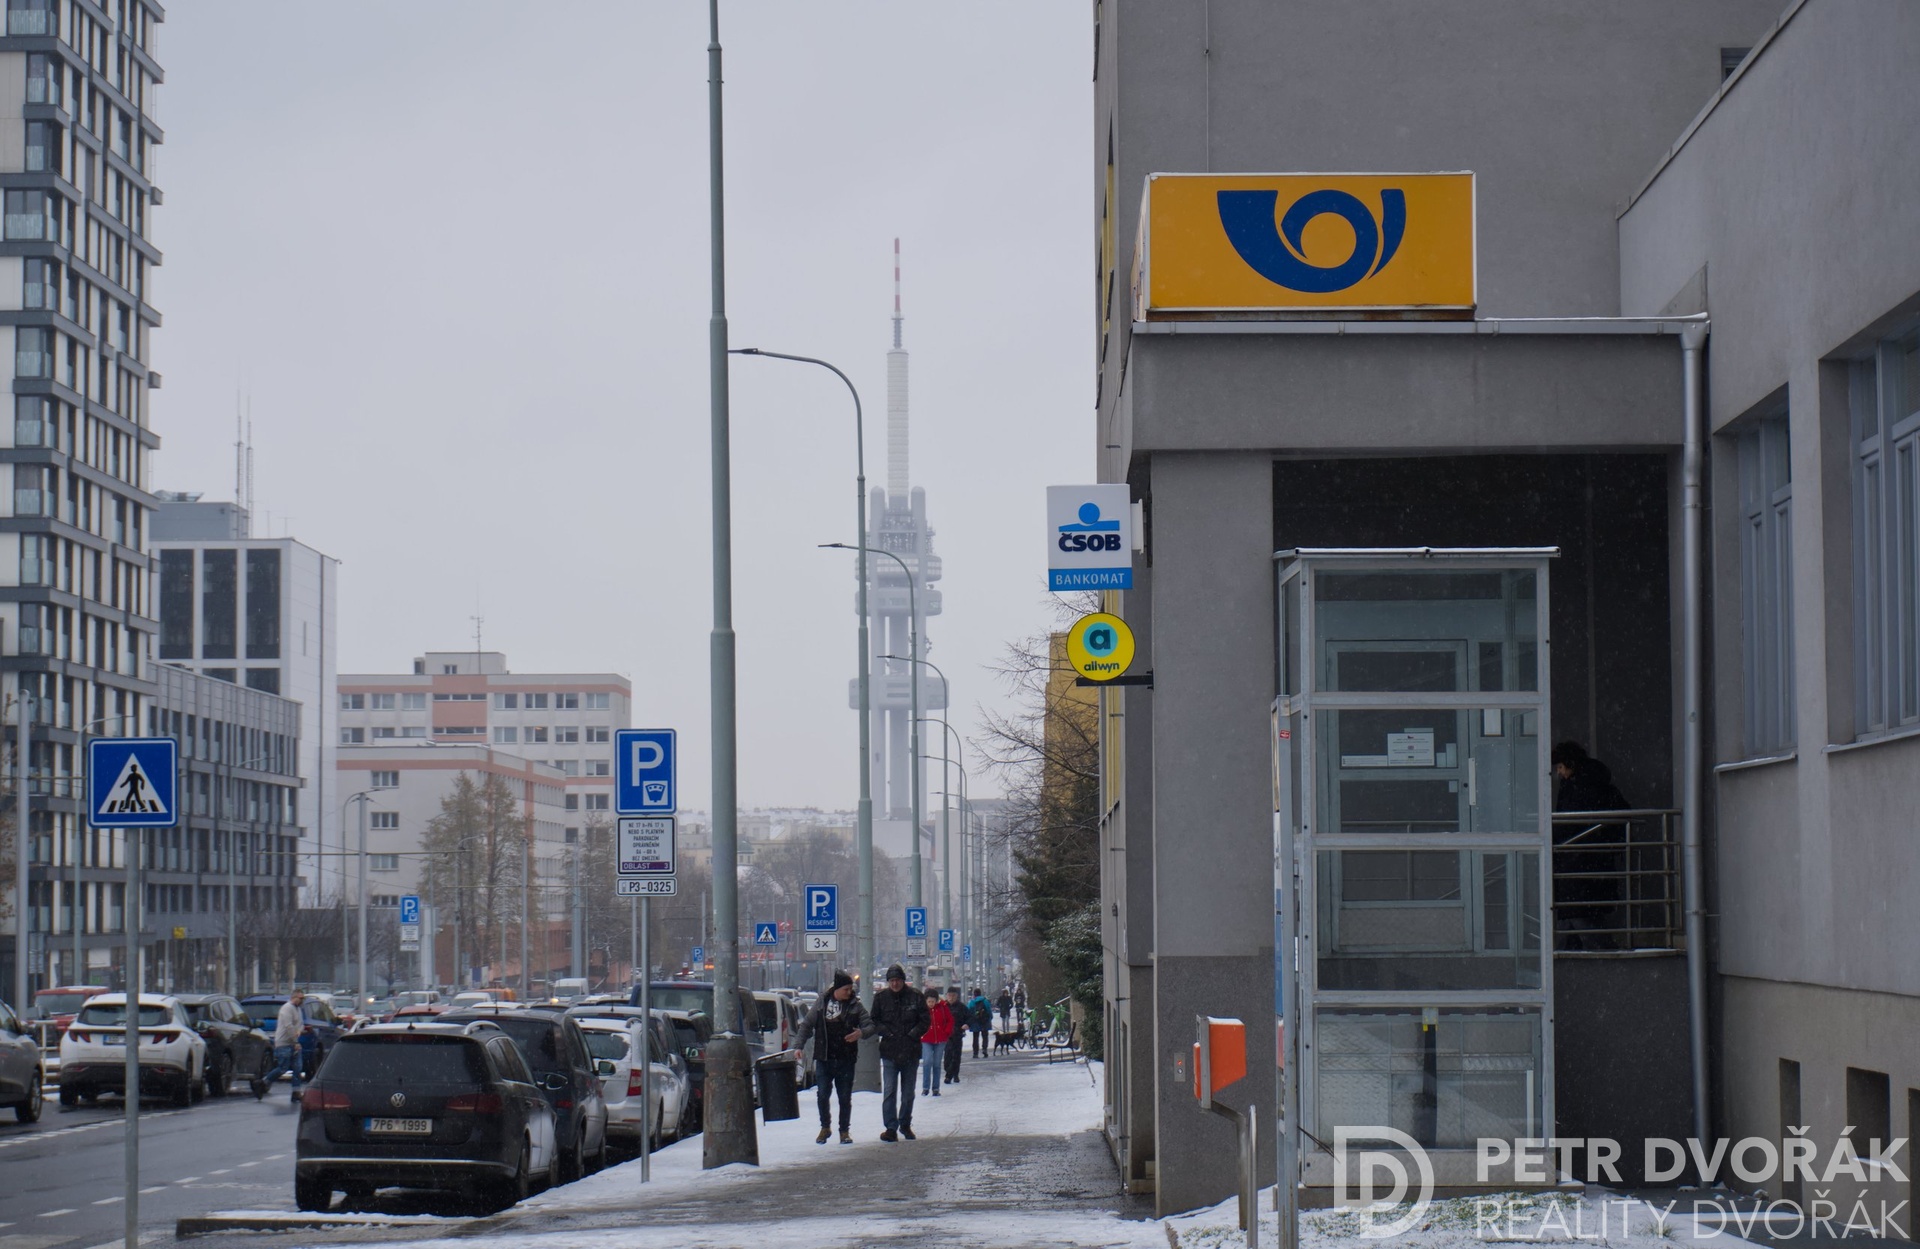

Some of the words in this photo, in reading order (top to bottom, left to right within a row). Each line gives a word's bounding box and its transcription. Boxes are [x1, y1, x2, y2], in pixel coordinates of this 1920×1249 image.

[1058, 532, 1121, 552] ČSOB
[1055, 573, 1125, 585] BANKOMAT
[1089, 629, 1111, 650] a
[1083, 661, 1120, 674] allwyn
[631, 741, 664, 787] P
[629, 881, 672, 893] P3-0325
[404, 899, 416, 915] P
[811, 890, 831, 917] P
[910, 911, 922, 928] P
[941, 931, 951, 944] P
[373, 1119, 394, 1130] 7P6
[401, 1120, 427, 1131] 1999
